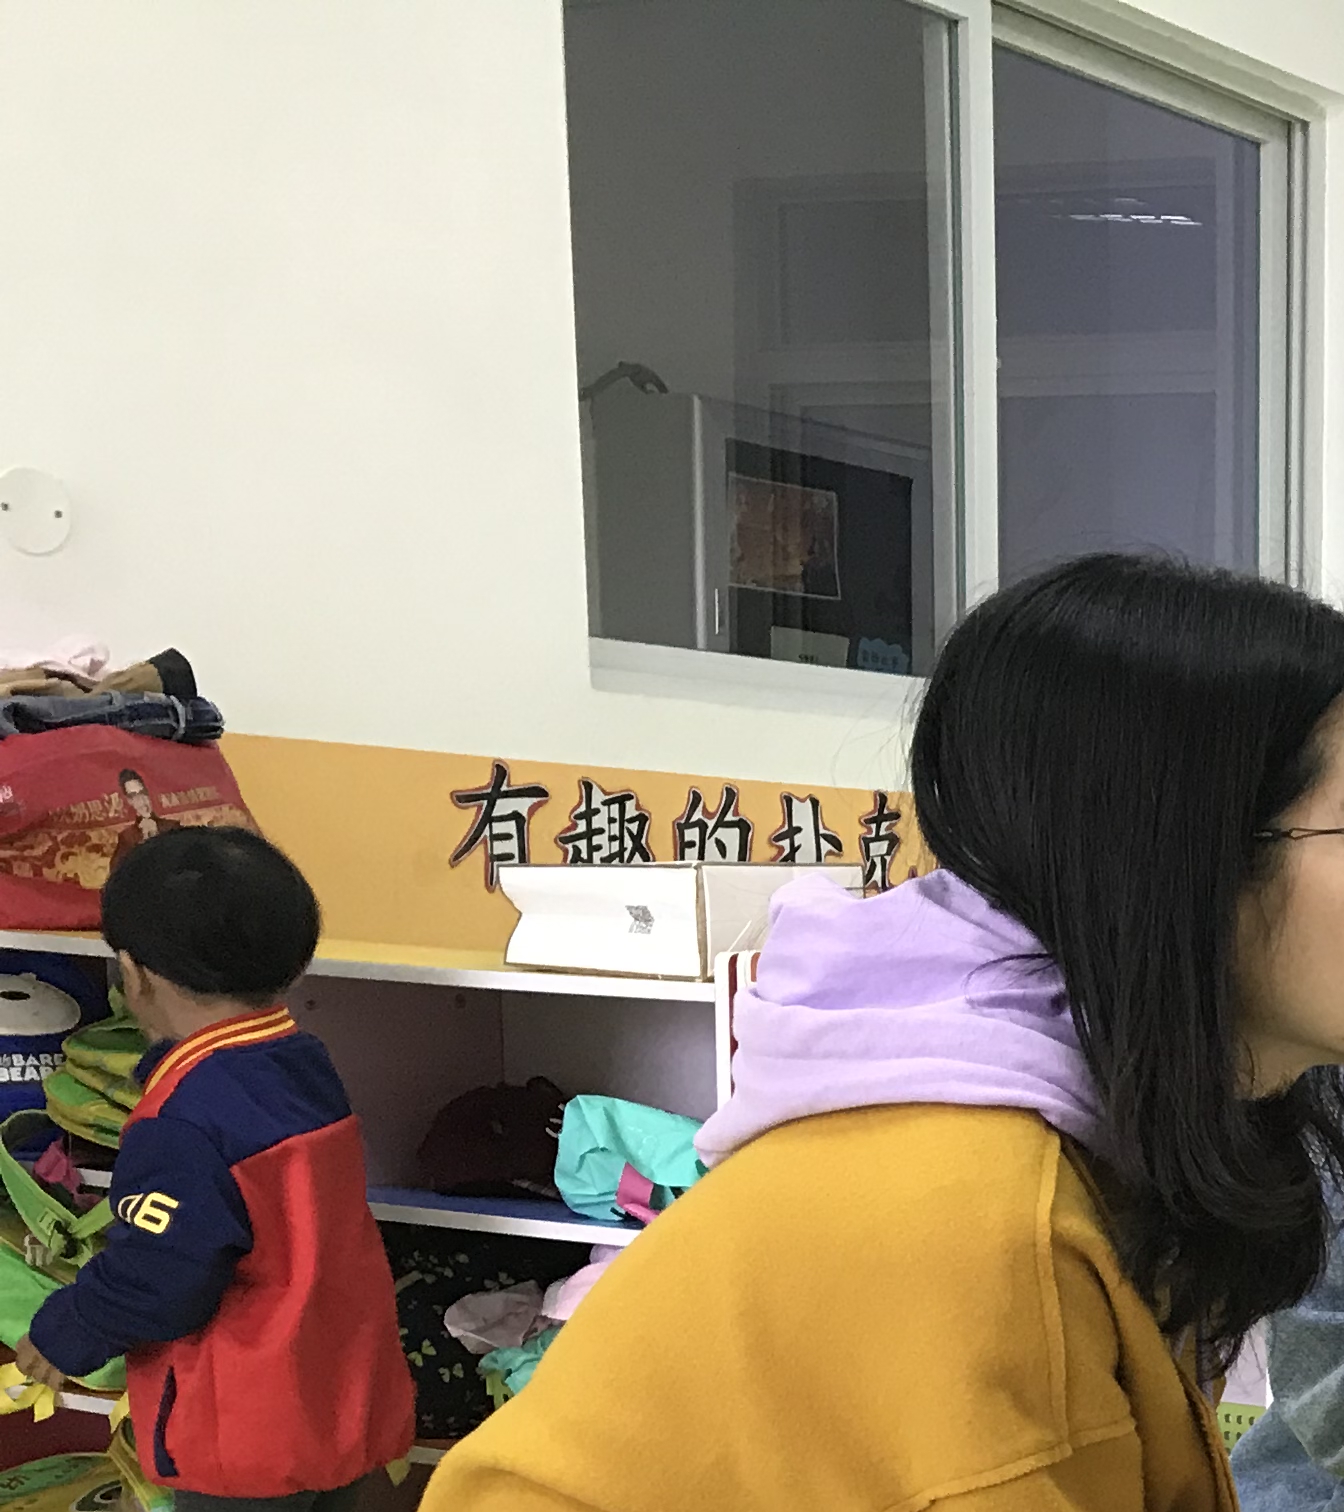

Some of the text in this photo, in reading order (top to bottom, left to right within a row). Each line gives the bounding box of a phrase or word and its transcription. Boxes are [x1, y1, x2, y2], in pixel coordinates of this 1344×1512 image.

[451, 762, 902, 891] 有趣的扑克
